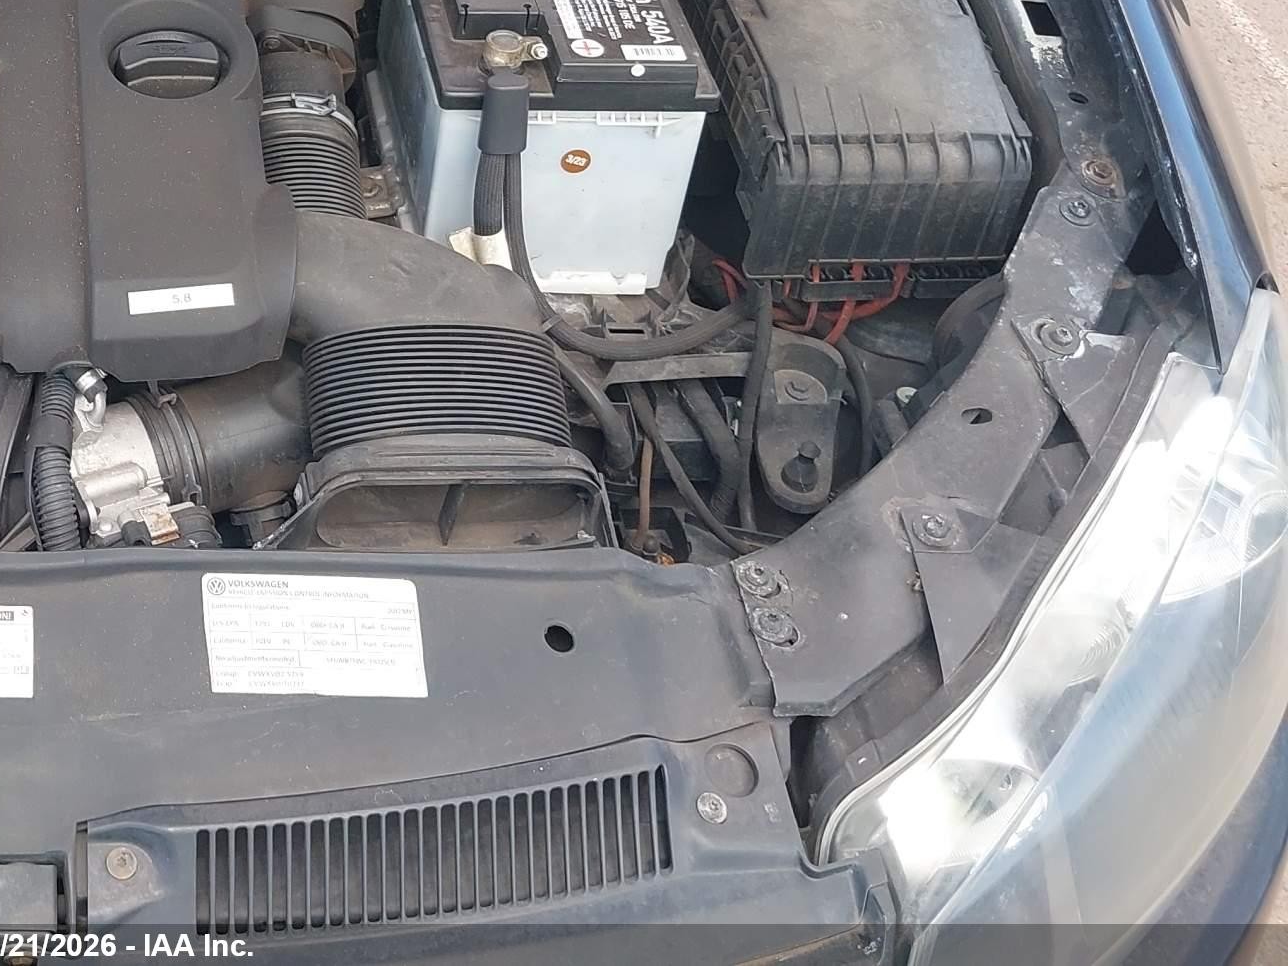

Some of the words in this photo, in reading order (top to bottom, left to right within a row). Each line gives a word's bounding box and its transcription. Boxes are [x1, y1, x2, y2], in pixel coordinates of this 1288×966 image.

[641, 10, 674, 44] 540A
[565, 154, 587, 167] 3/23
[227, 579, 289, 589] VOLKSWAGEN
